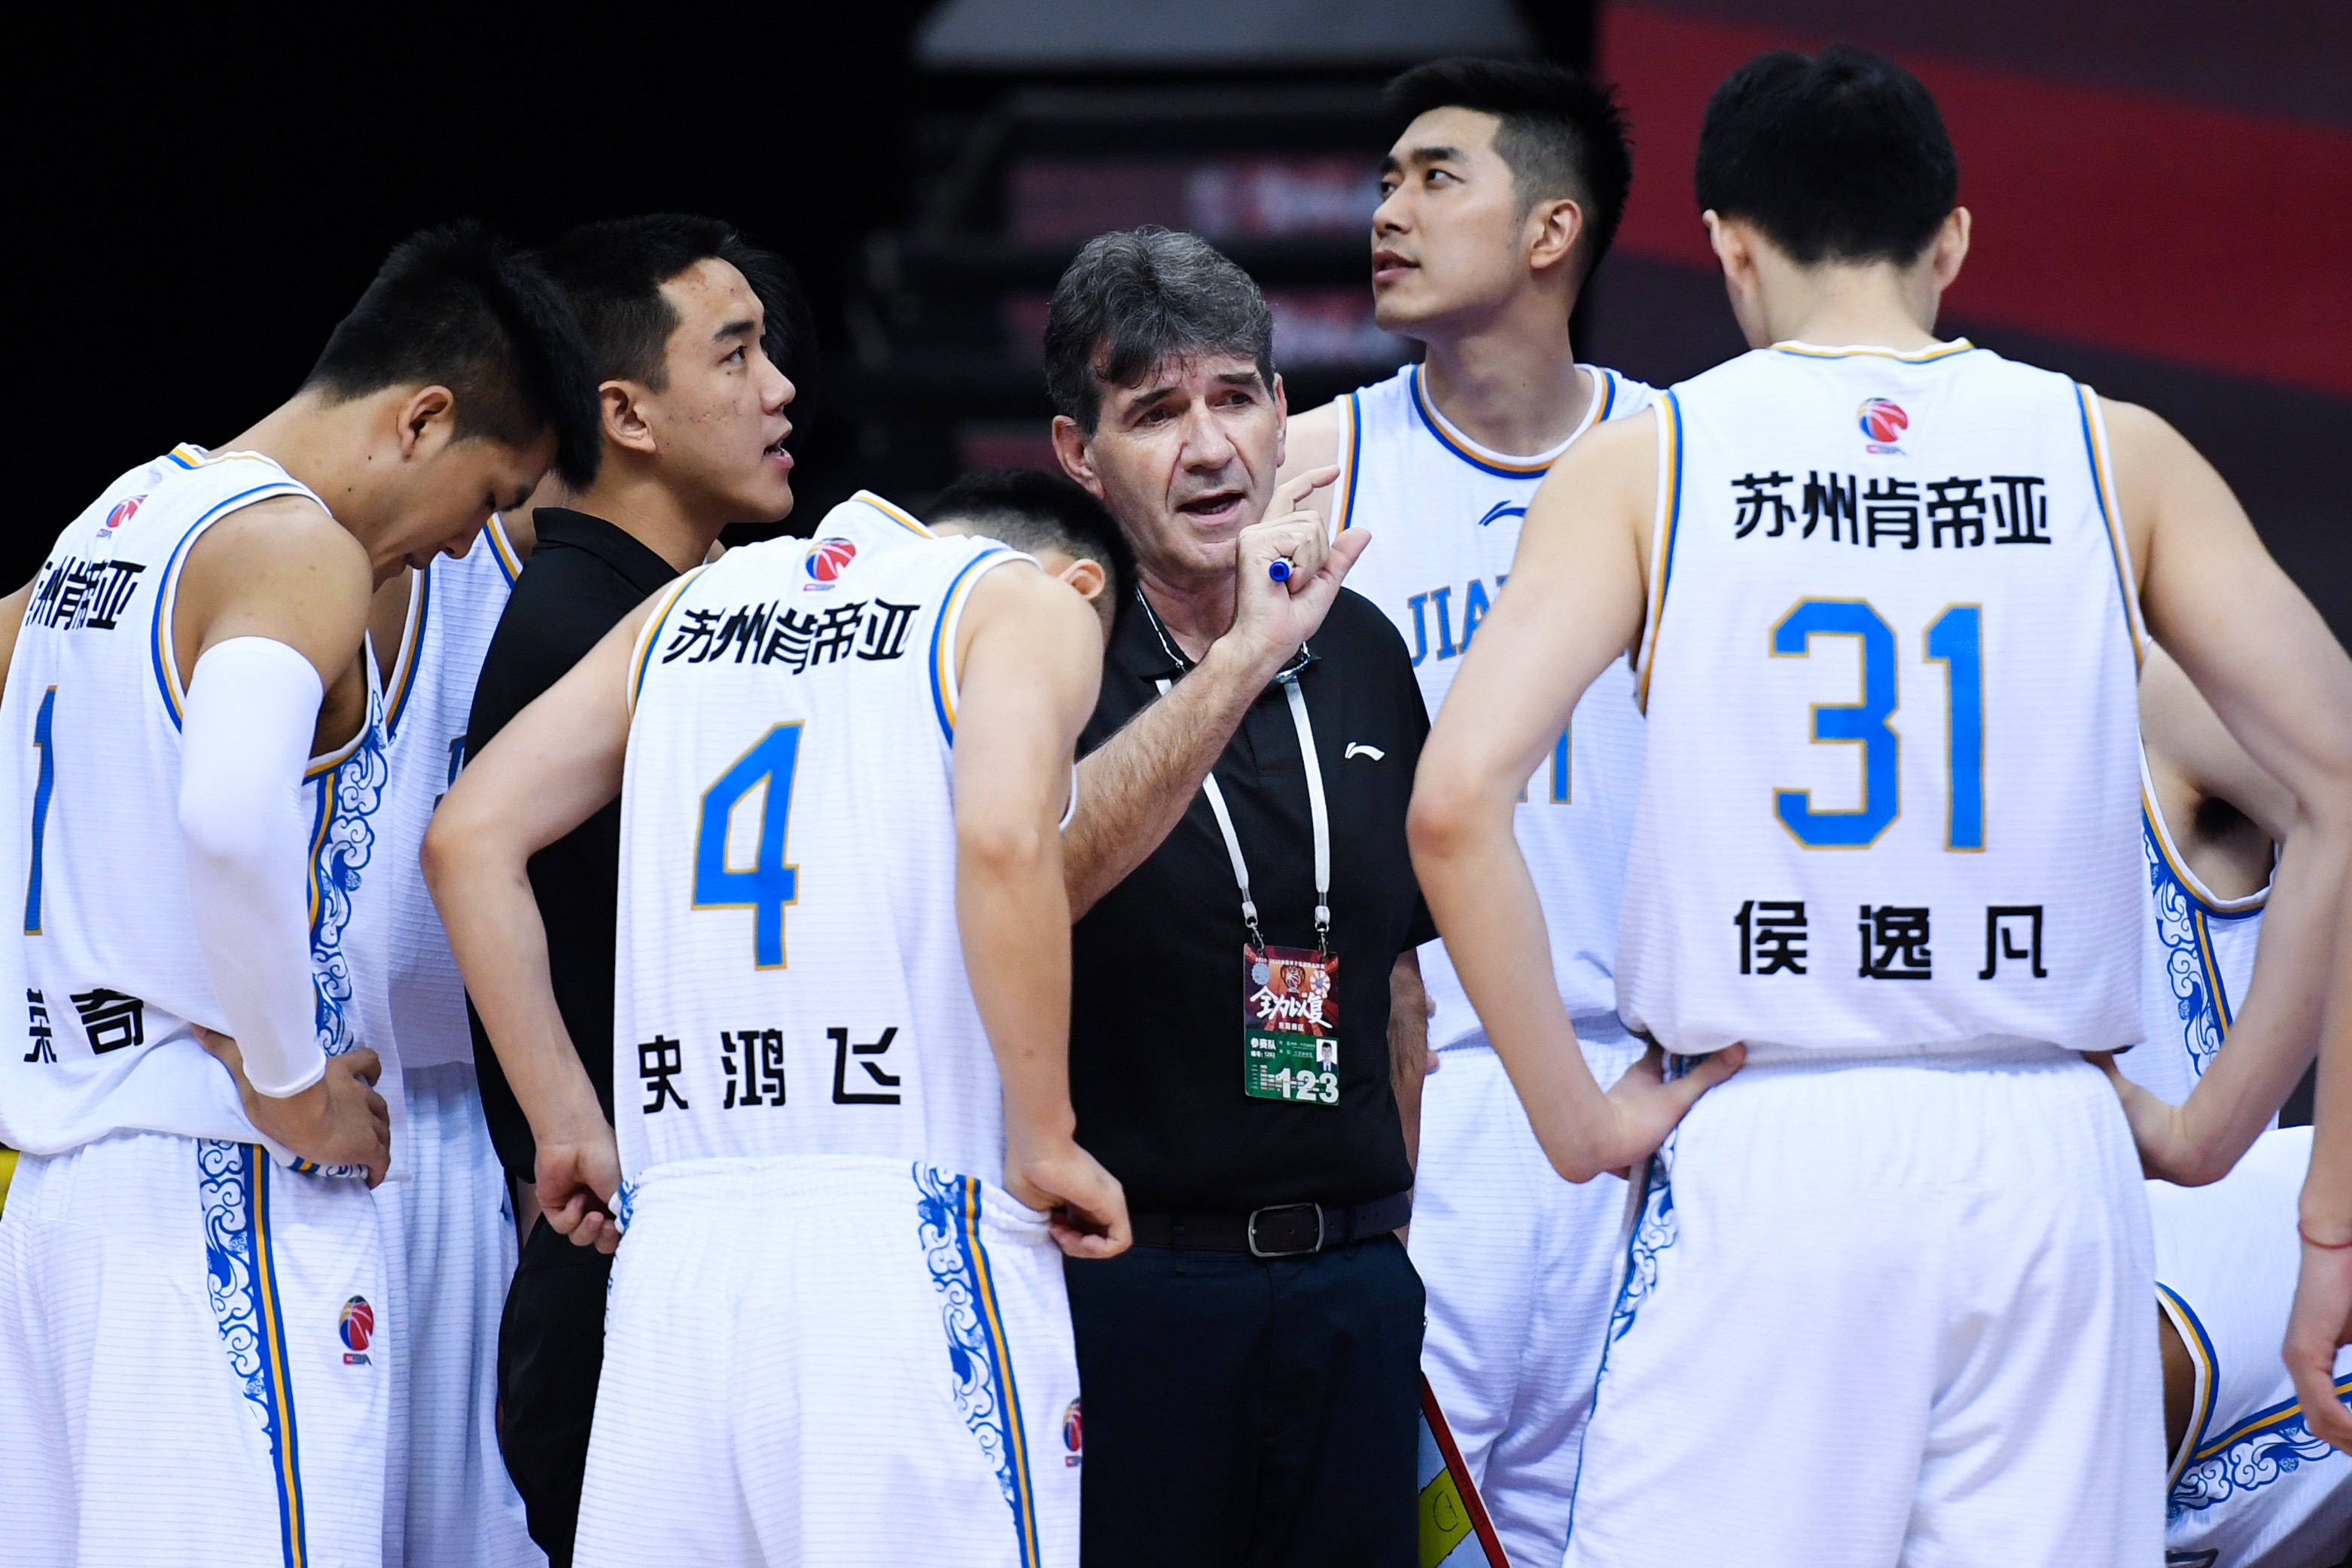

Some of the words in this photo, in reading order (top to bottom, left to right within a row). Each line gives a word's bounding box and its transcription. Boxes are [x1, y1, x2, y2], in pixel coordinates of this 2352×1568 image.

[1731, 470, 2052, 550] 苏州肯帝亚
[662, 597, 922, 675] 苏州肯帝亚
[1407, 574, 1509, 668] JIA
[1769, 595, 1987, 854] 31
[23, 684, 57, 936] 1
[690, 719, 806, 971] 4
[1733, 900, 2049, 981] 侯逸凡
[638, 1027, 902, 1115] 史鸿飞
[1275, 1067, 1339, 1104] 123
